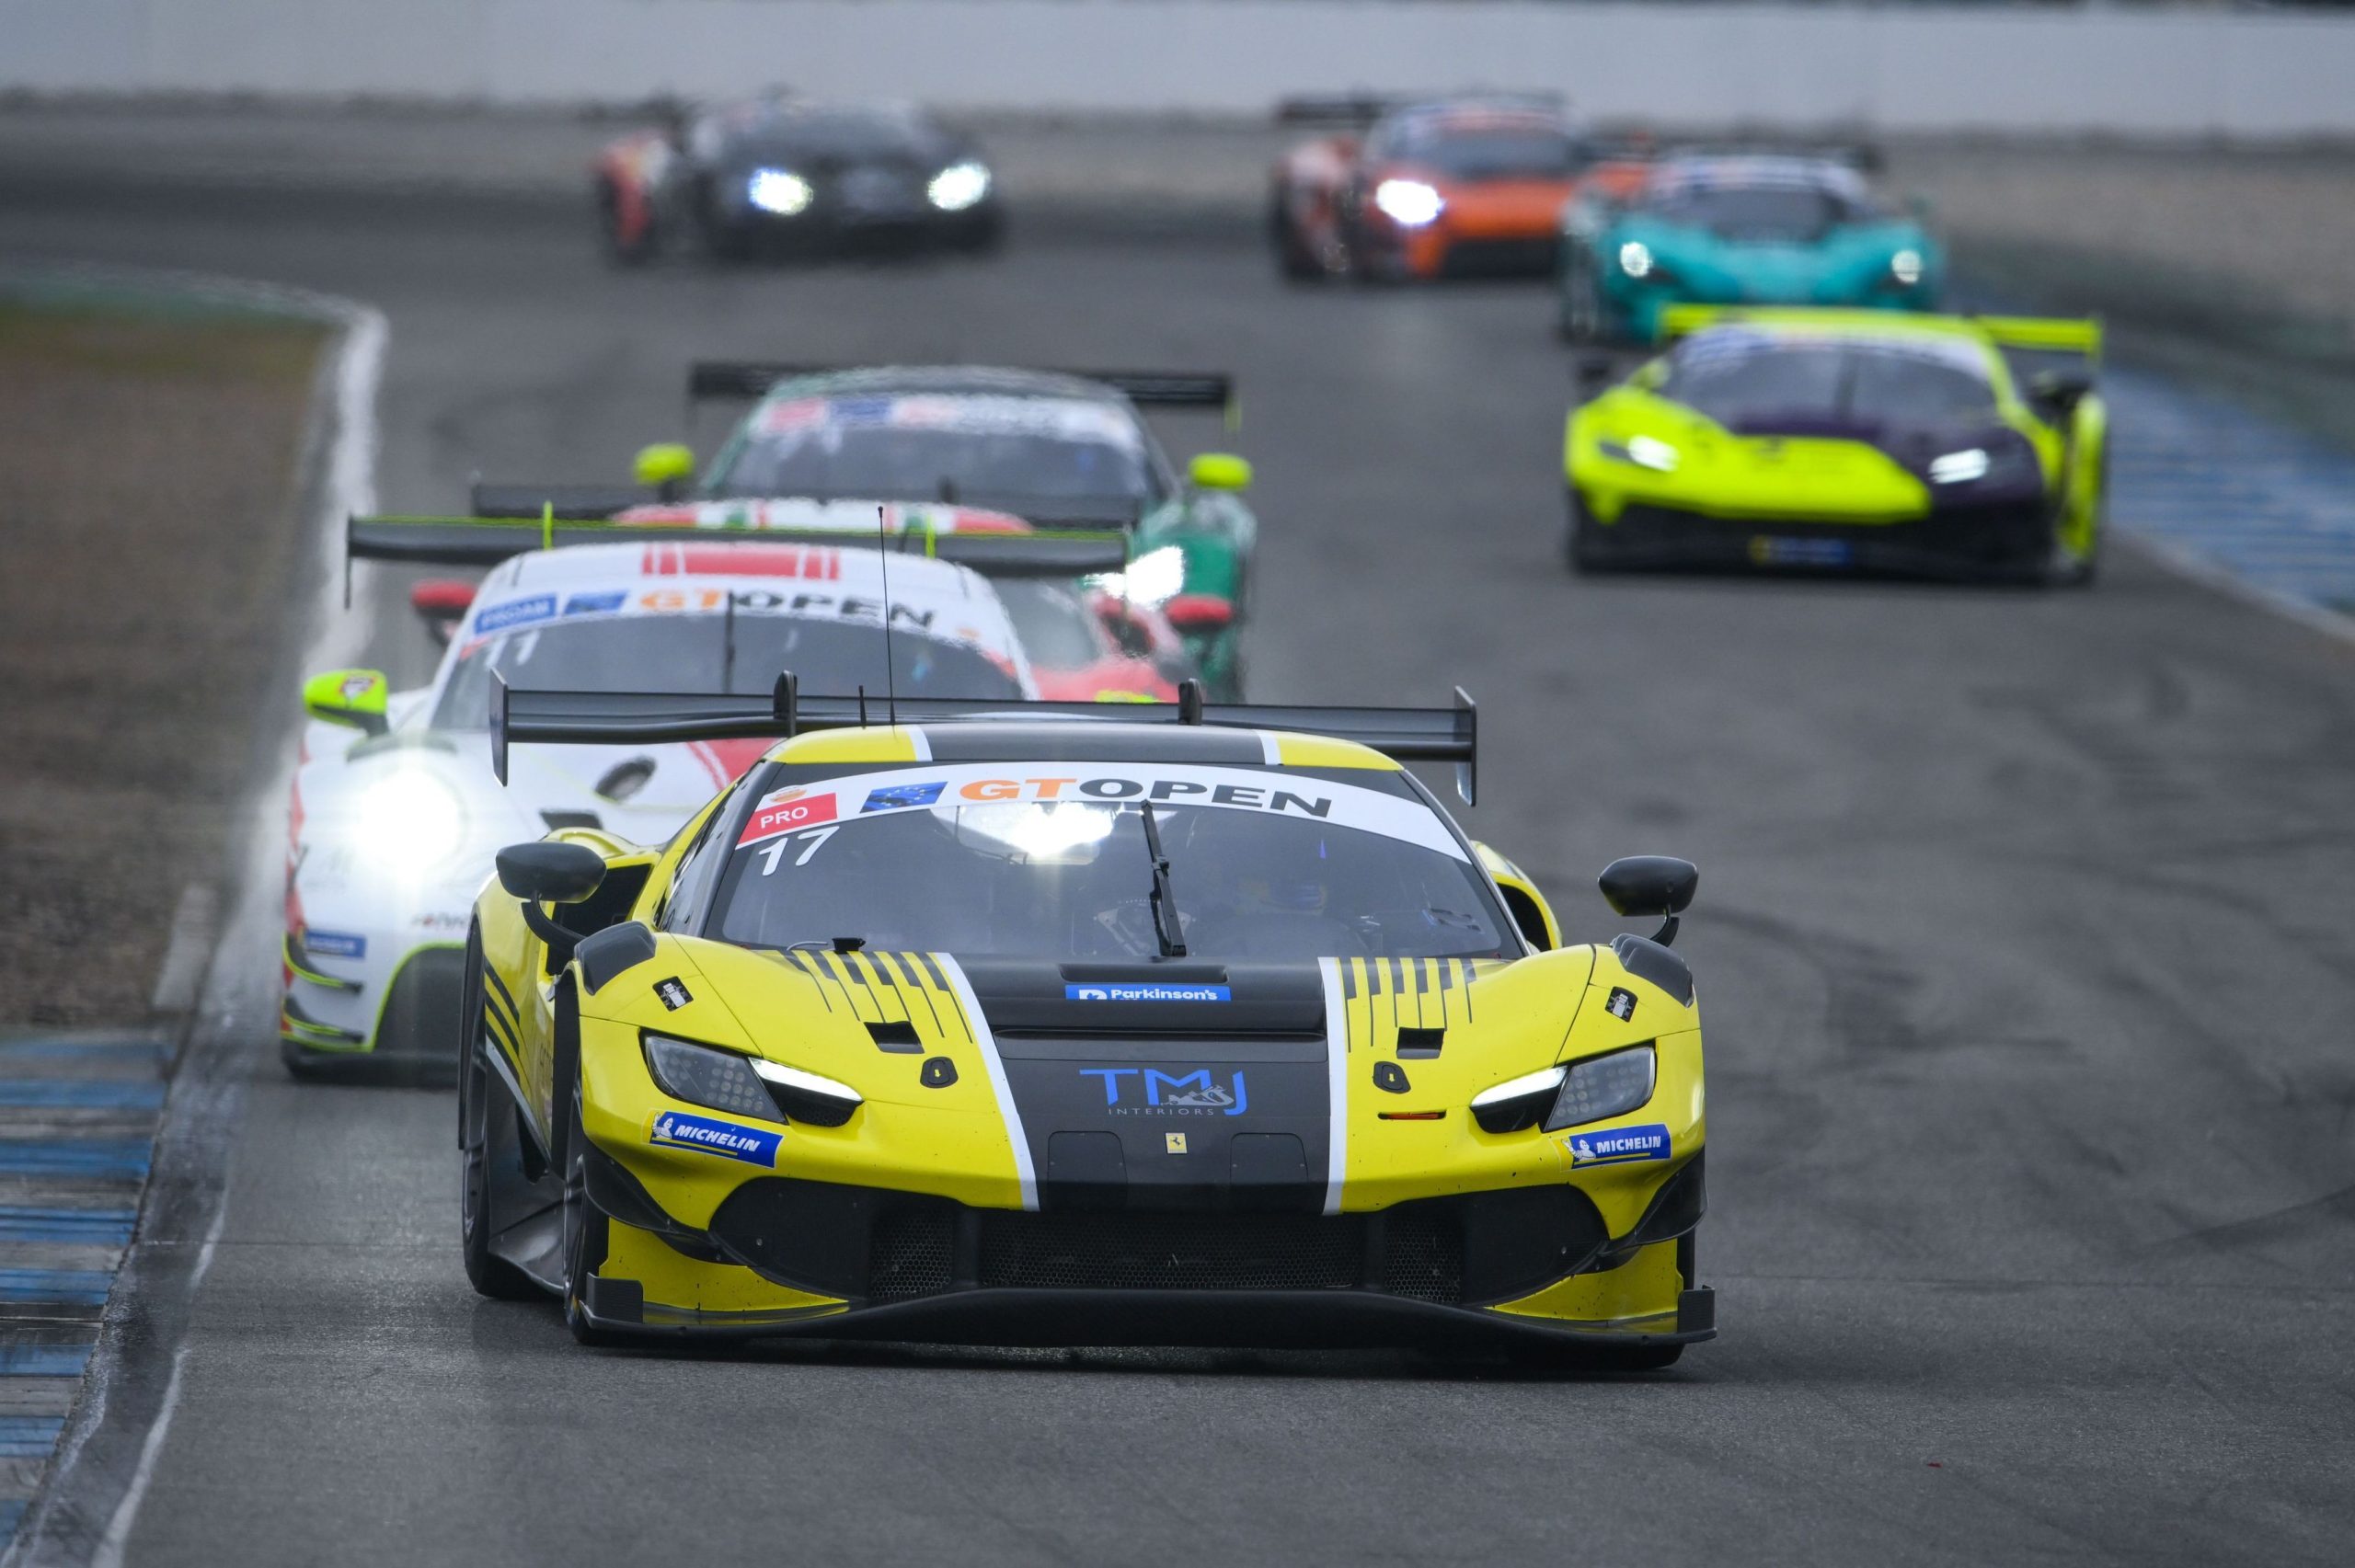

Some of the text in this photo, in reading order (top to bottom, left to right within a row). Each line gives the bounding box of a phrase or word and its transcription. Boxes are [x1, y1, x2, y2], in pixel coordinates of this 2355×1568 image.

[760, 807, 809, 829] PRO
[759, 826, 840, 876] 17
[1110, 989, 1218, 1001] Parkinson's
[1079, 1068, 1247, 1116] TMJ
[1108, 1107, 1214, 1116] INTERIORS
[674, 1124, 761, 1152] MICHELIN
[1596, 1135, 1661, 1153] MICHELIN
